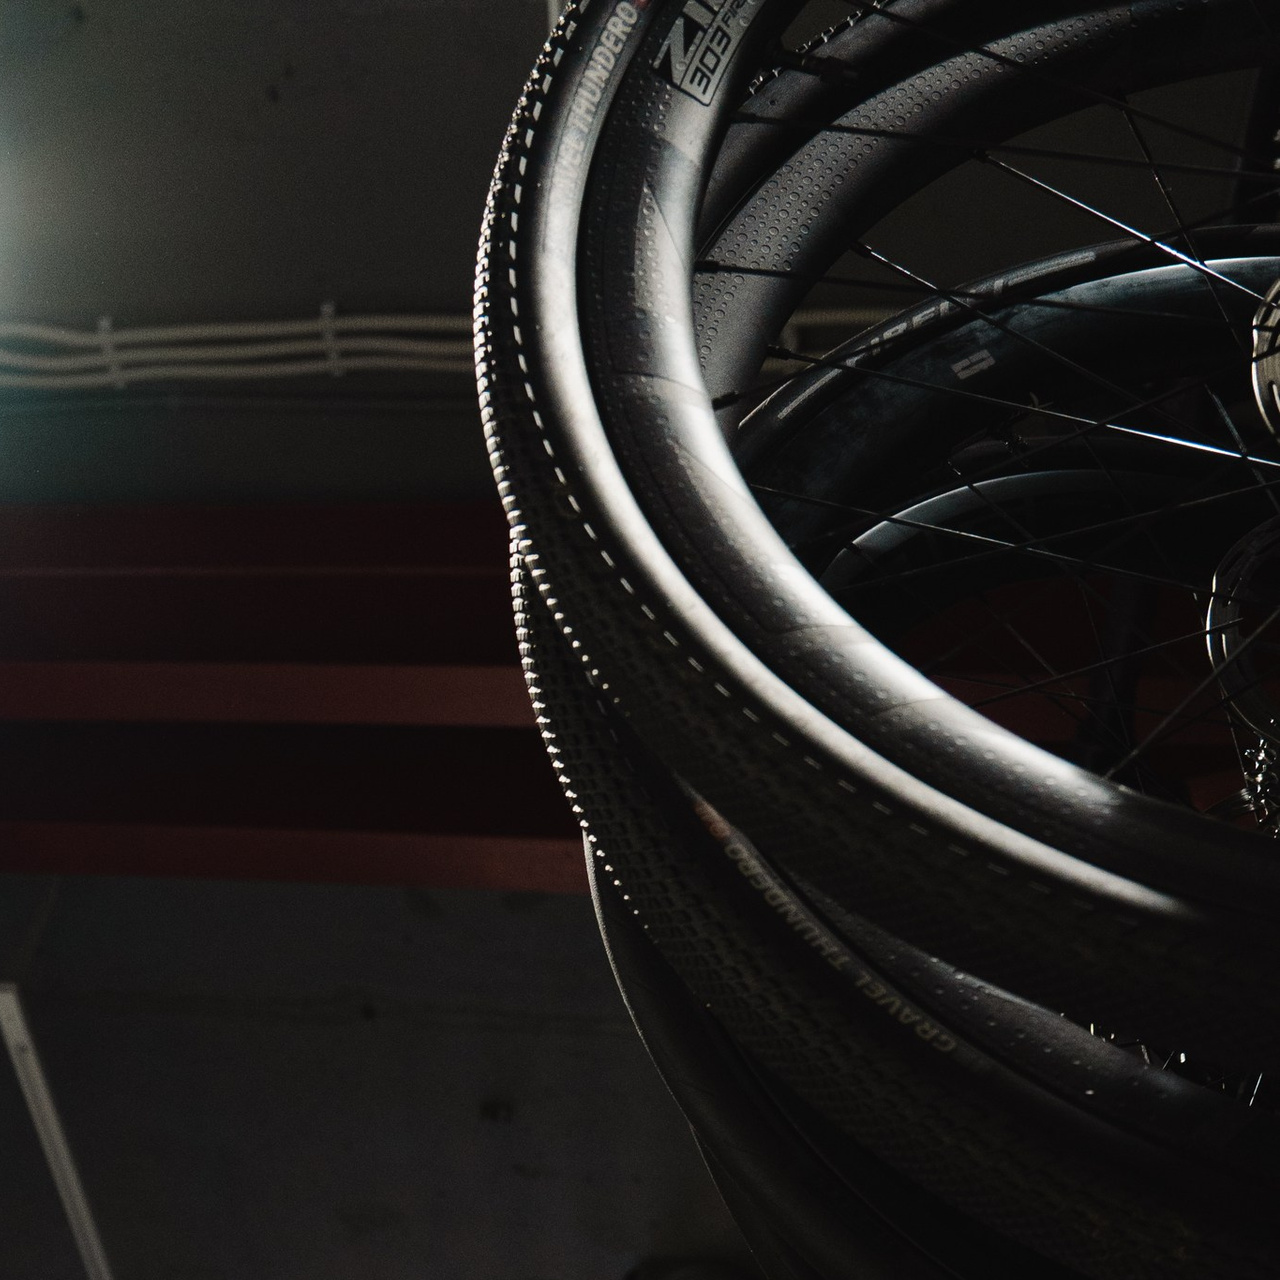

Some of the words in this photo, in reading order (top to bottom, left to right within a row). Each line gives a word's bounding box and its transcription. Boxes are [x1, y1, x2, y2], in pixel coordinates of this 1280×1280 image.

[570, 2, 638, 136] THUNDERO
[689, 26, 731, 95] 303
[723, 842, 852, 970] THUNDERO
[853, 969, 957, 1053] GRAVEL
